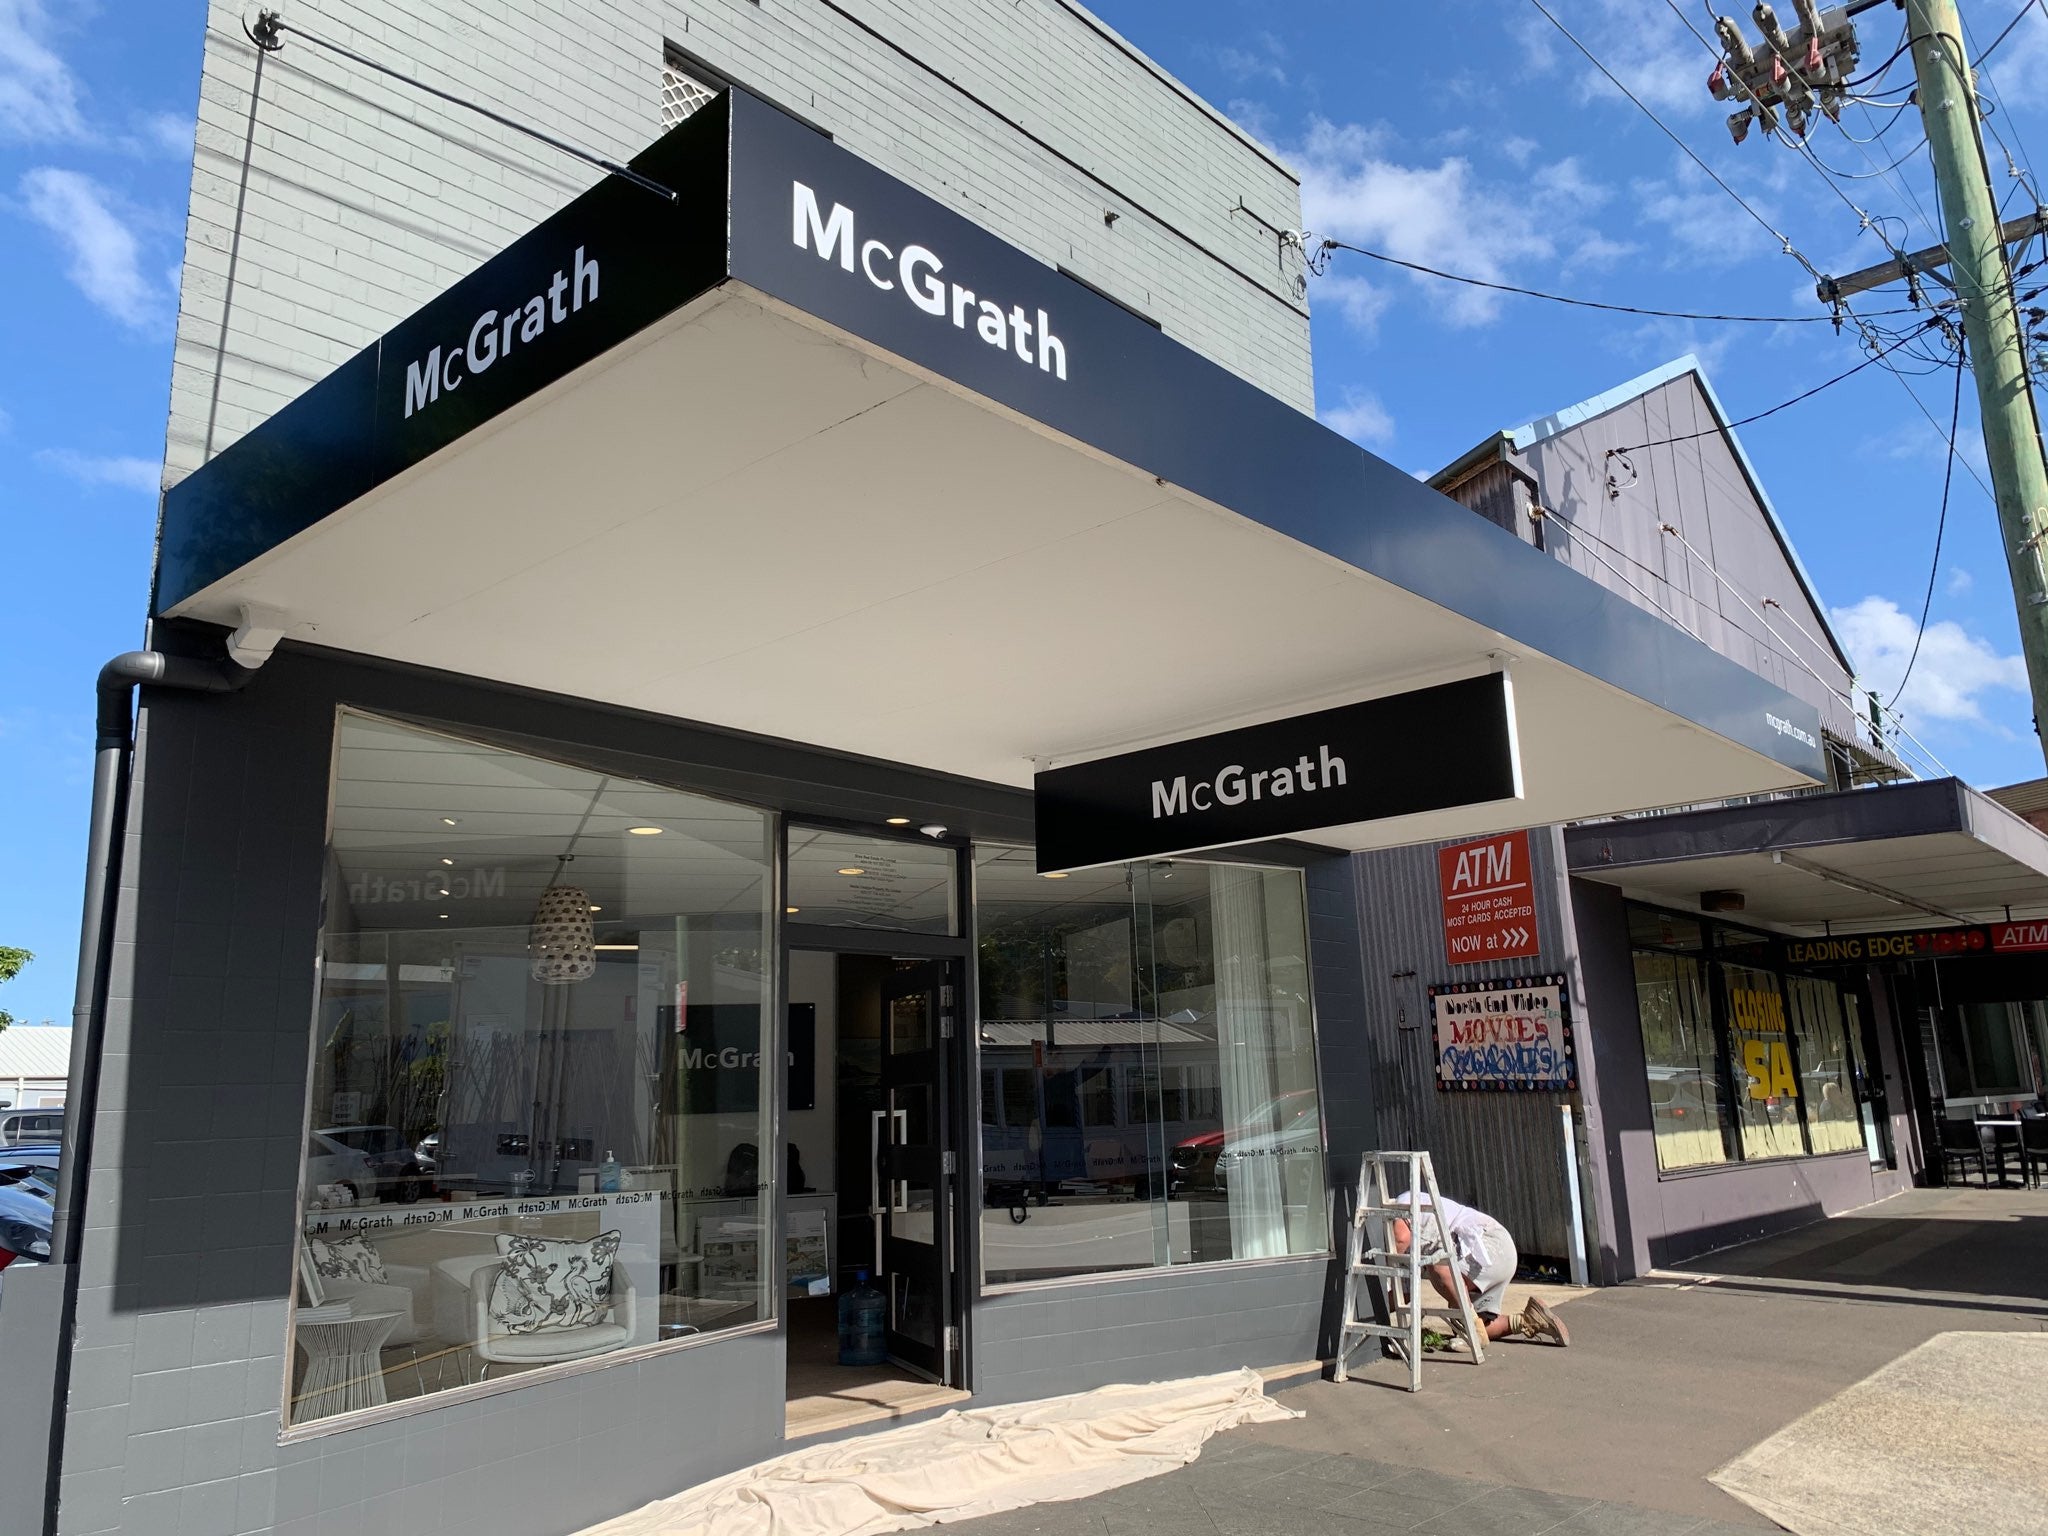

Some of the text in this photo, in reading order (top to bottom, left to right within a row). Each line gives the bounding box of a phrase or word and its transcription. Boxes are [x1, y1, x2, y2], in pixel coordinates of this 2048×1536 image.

[793, 180, 1067, 381] McGrath
[404, 245, 599, 419] McGrath
[1765, 712, 1817, 748] mcgrath.com.au
[1151, 745, 1347, 818] McGrath
[1452, 841, 1512, 890] ATM
[1447, 906, 1532, 927] MOST CARDS ACCEPTED
[1461, 896, 1512, 913] 24 HOUR CASH
[1452, 934, 1498, 953] NOW at
[1787, 939, 1861, 963] LEADING
[1868, 936, 1914, 957] EDGE
[2002, 925, 2048, 944] ATM
[1445, 993, 1549, 1014] North End Video
[1733, 988, 1786, 1032] CLOSING
[1450, 1018, 1548, 1044] MOVIES
[340, 1215, 393, 1232] McGrath
[463, 1204, 509, 1219] McGrath
[568, 1196, 608, 1209] McGrath
